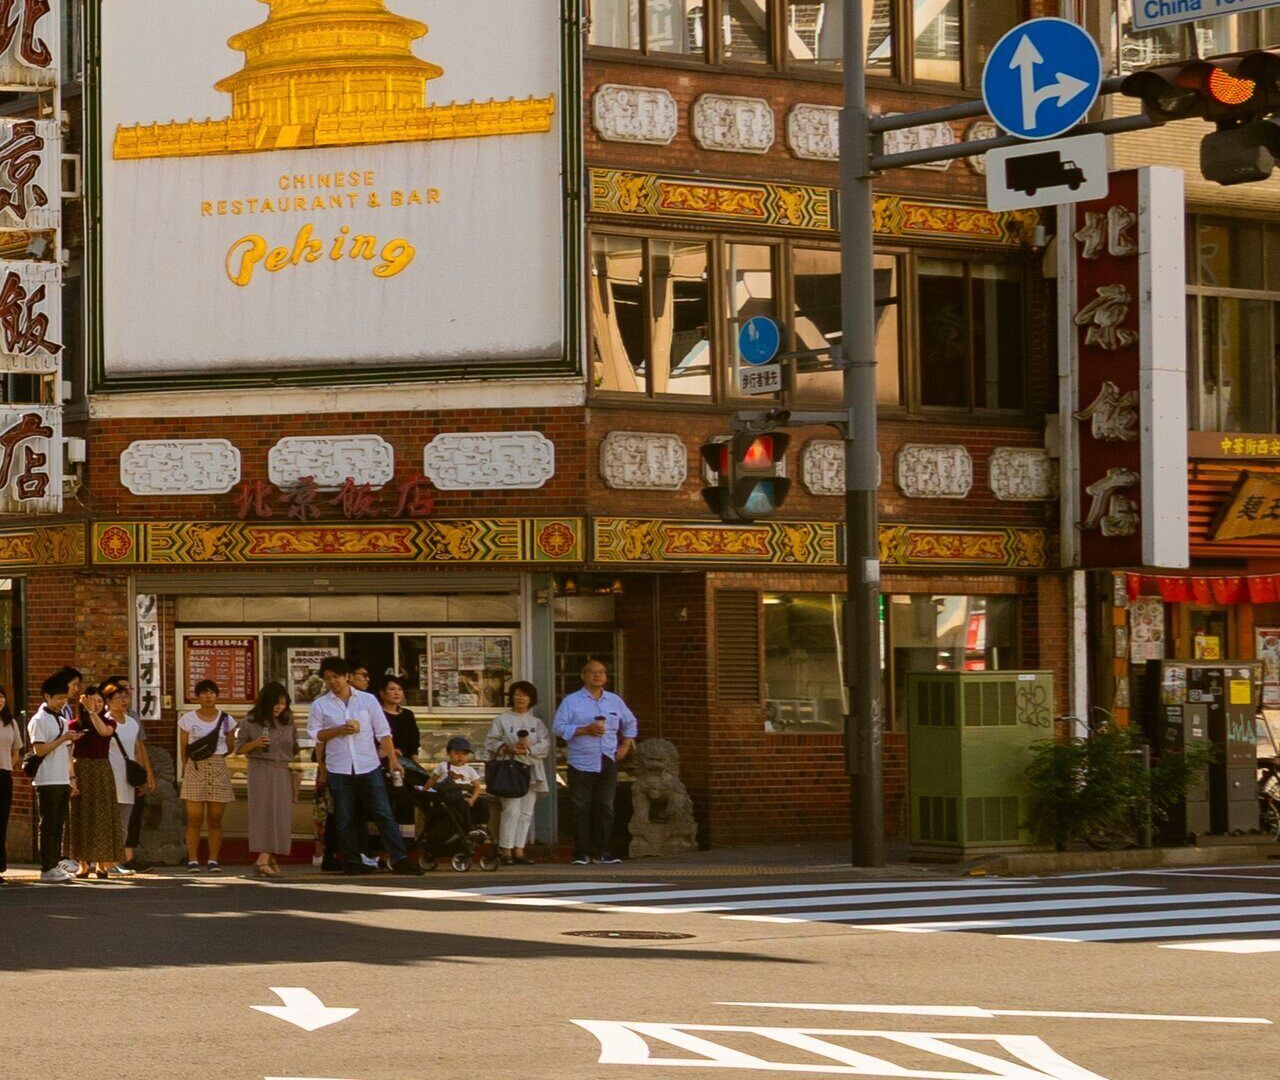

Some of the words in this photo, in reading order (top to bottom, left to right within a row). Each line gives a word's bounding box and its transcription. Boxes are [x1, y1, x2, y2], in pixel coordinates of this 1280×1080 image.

[279, 170, 376, 191] CHINESE
[200, 191, 359, 217] RESTAURANT
[367, 191, 382, 209] &
[391, 187, 441, 207] BAR
[225, 222, 416, 287] Peking
[233, 475, 434, 521] 北京飯店
